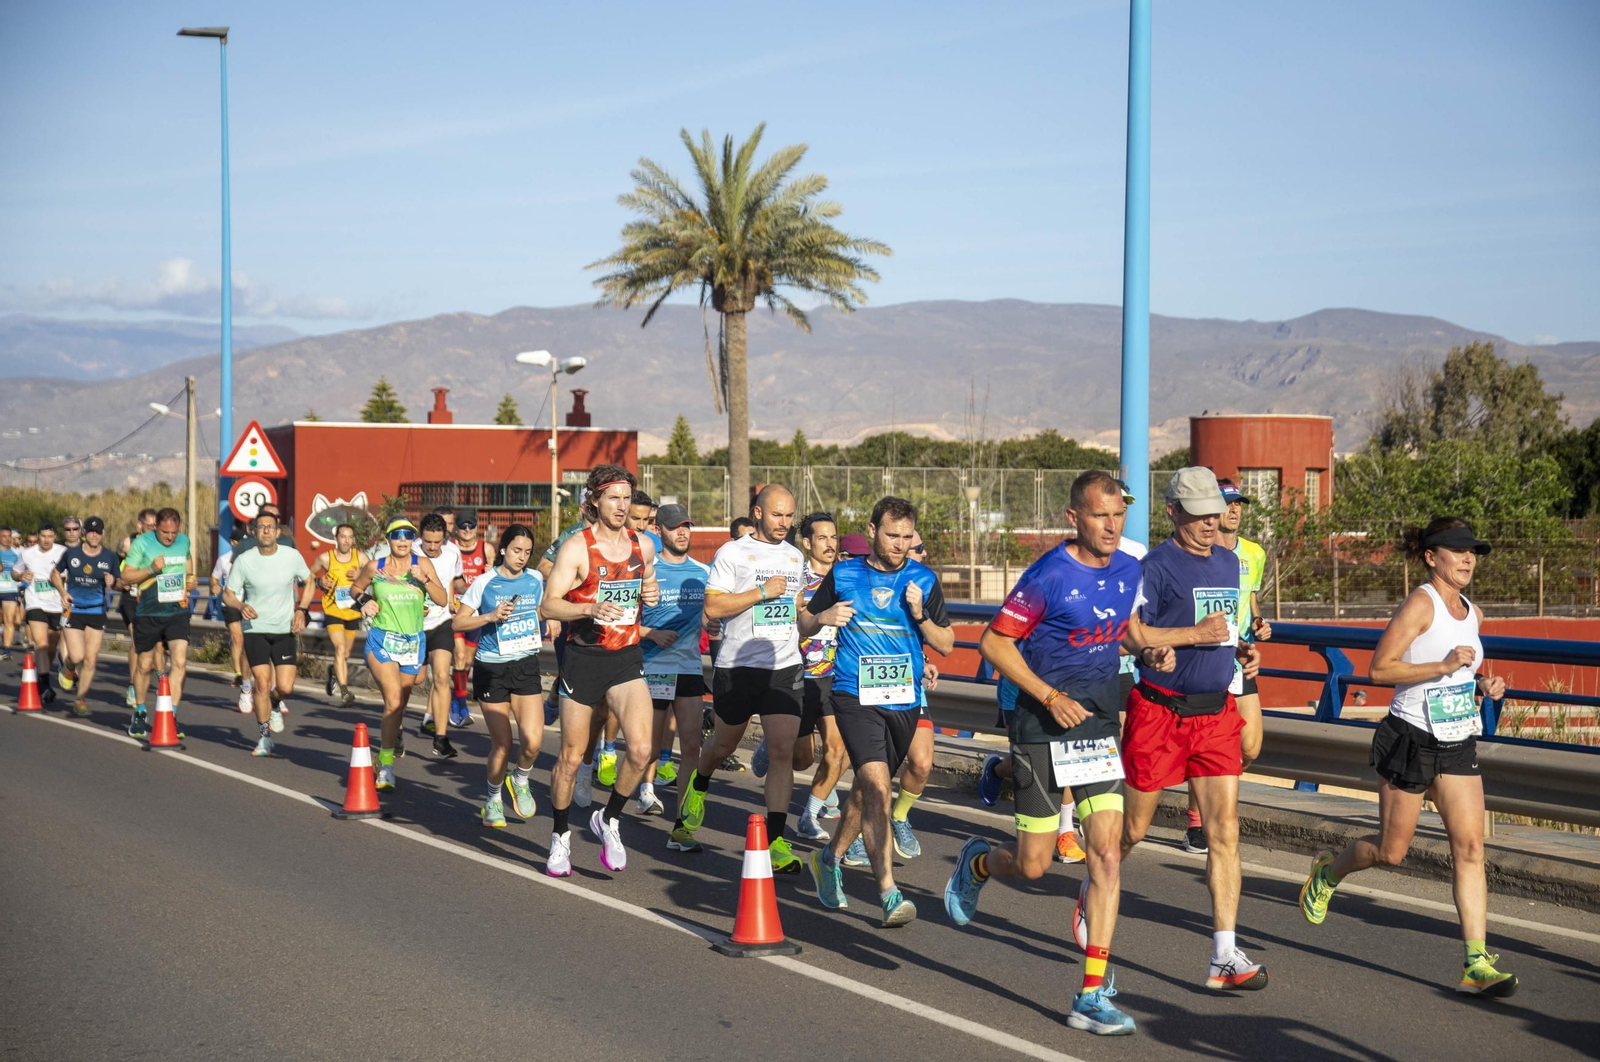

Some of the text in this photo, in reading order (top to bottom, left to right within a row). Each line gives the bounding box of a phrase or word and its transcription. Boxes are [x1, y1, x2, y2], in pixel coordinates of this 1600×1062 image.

[239, 492, 267, 507] 30
[755, 568, 775, 576] Medio
[164, 578, 182, 588] 690
[388, 593, 418, 601] SAKATA
[604, 588, 638, 603] 2434
[661, 594, 688, 602] Almería
[1065, 593, 1087, 602] SPIRAL
[764, 605, 790, 619] 222
[1203, 599, 1238, 616] 1059
[501, 618, 536, 636] 2609
[388, 640, 417, 652] 1346
[867, 665, 908, 680] 1337
[1442, 692, 1473, 714] 525
